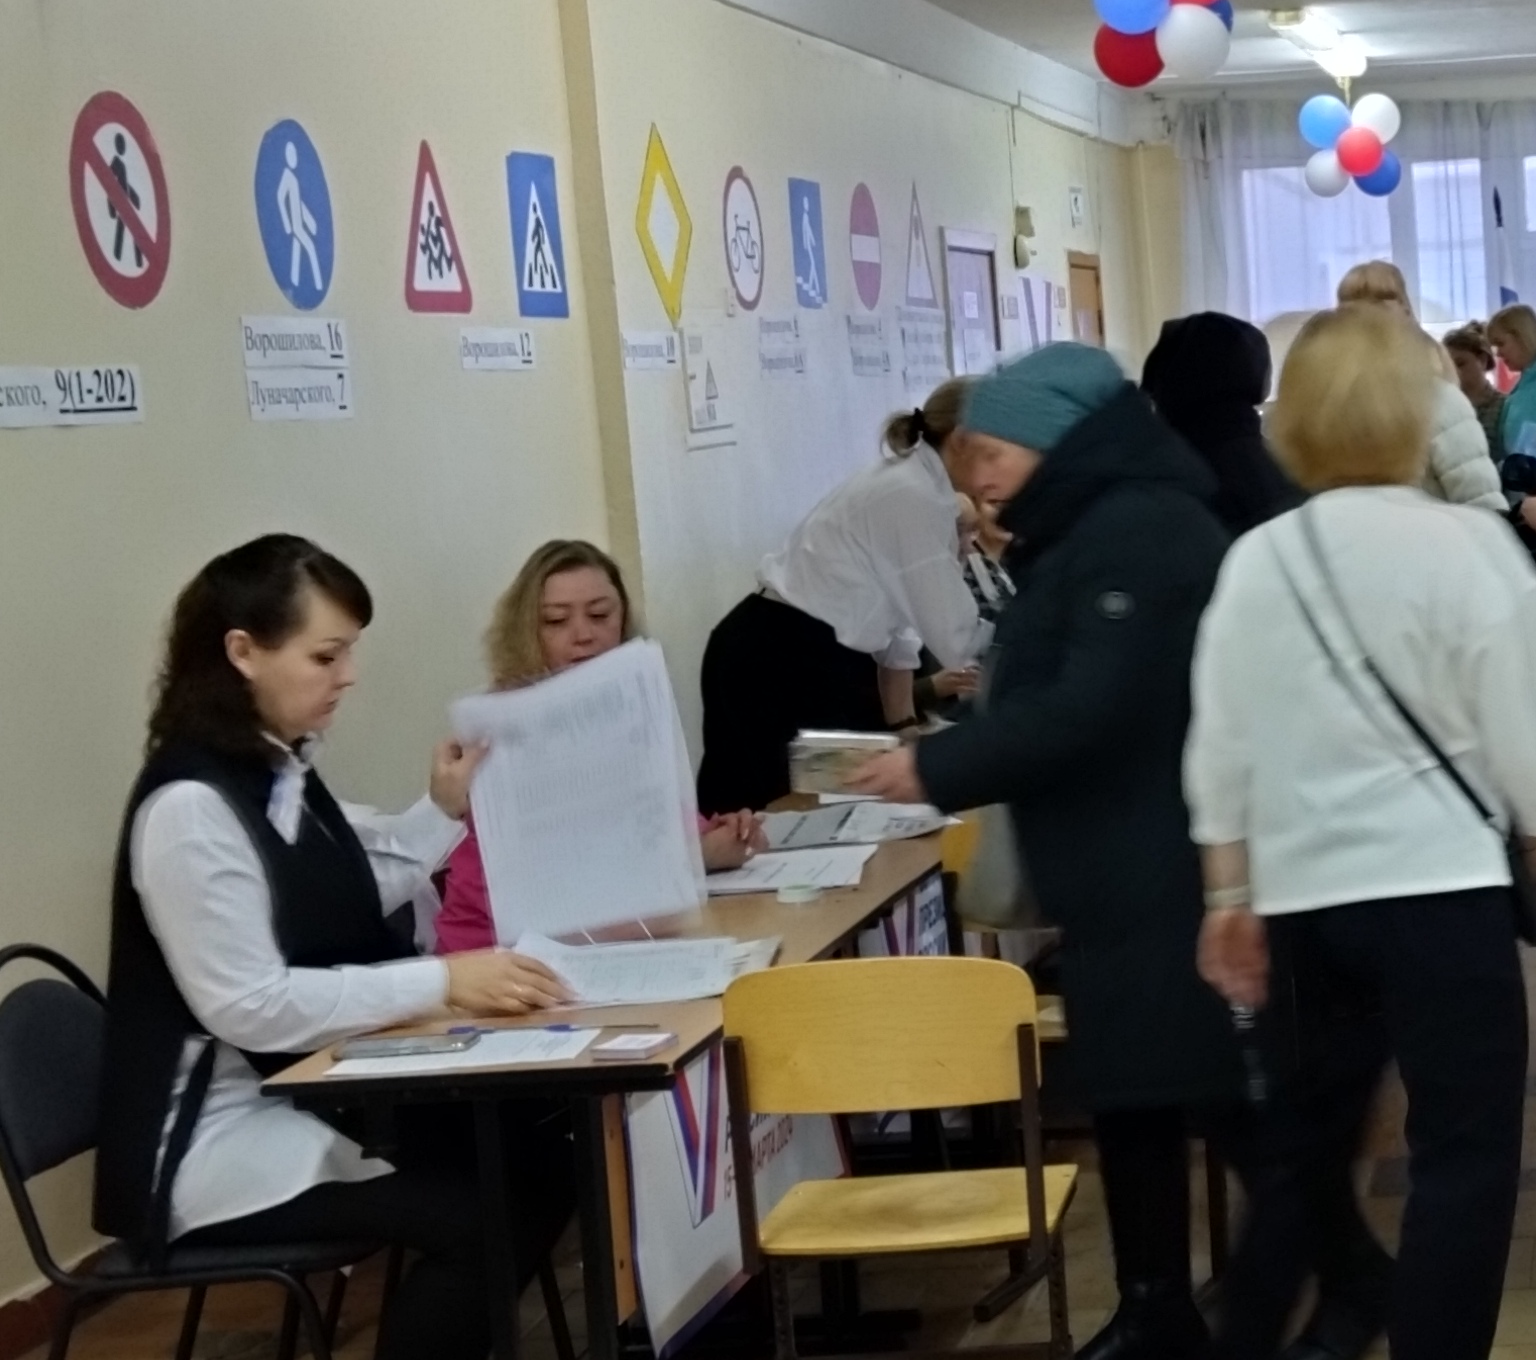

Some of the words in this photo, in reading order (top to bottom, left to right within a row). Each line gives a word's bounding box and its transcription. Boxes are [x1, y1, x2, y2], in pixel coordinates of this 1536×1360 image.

[244, 325, 326, 358] Ворошилова,
[327, 322, 344, 355] 16
[519, 332, 533, 362] 12
[54, 368, 137, 412] 9(1-202)
[251, 380, 336, 412] Луначарского,
